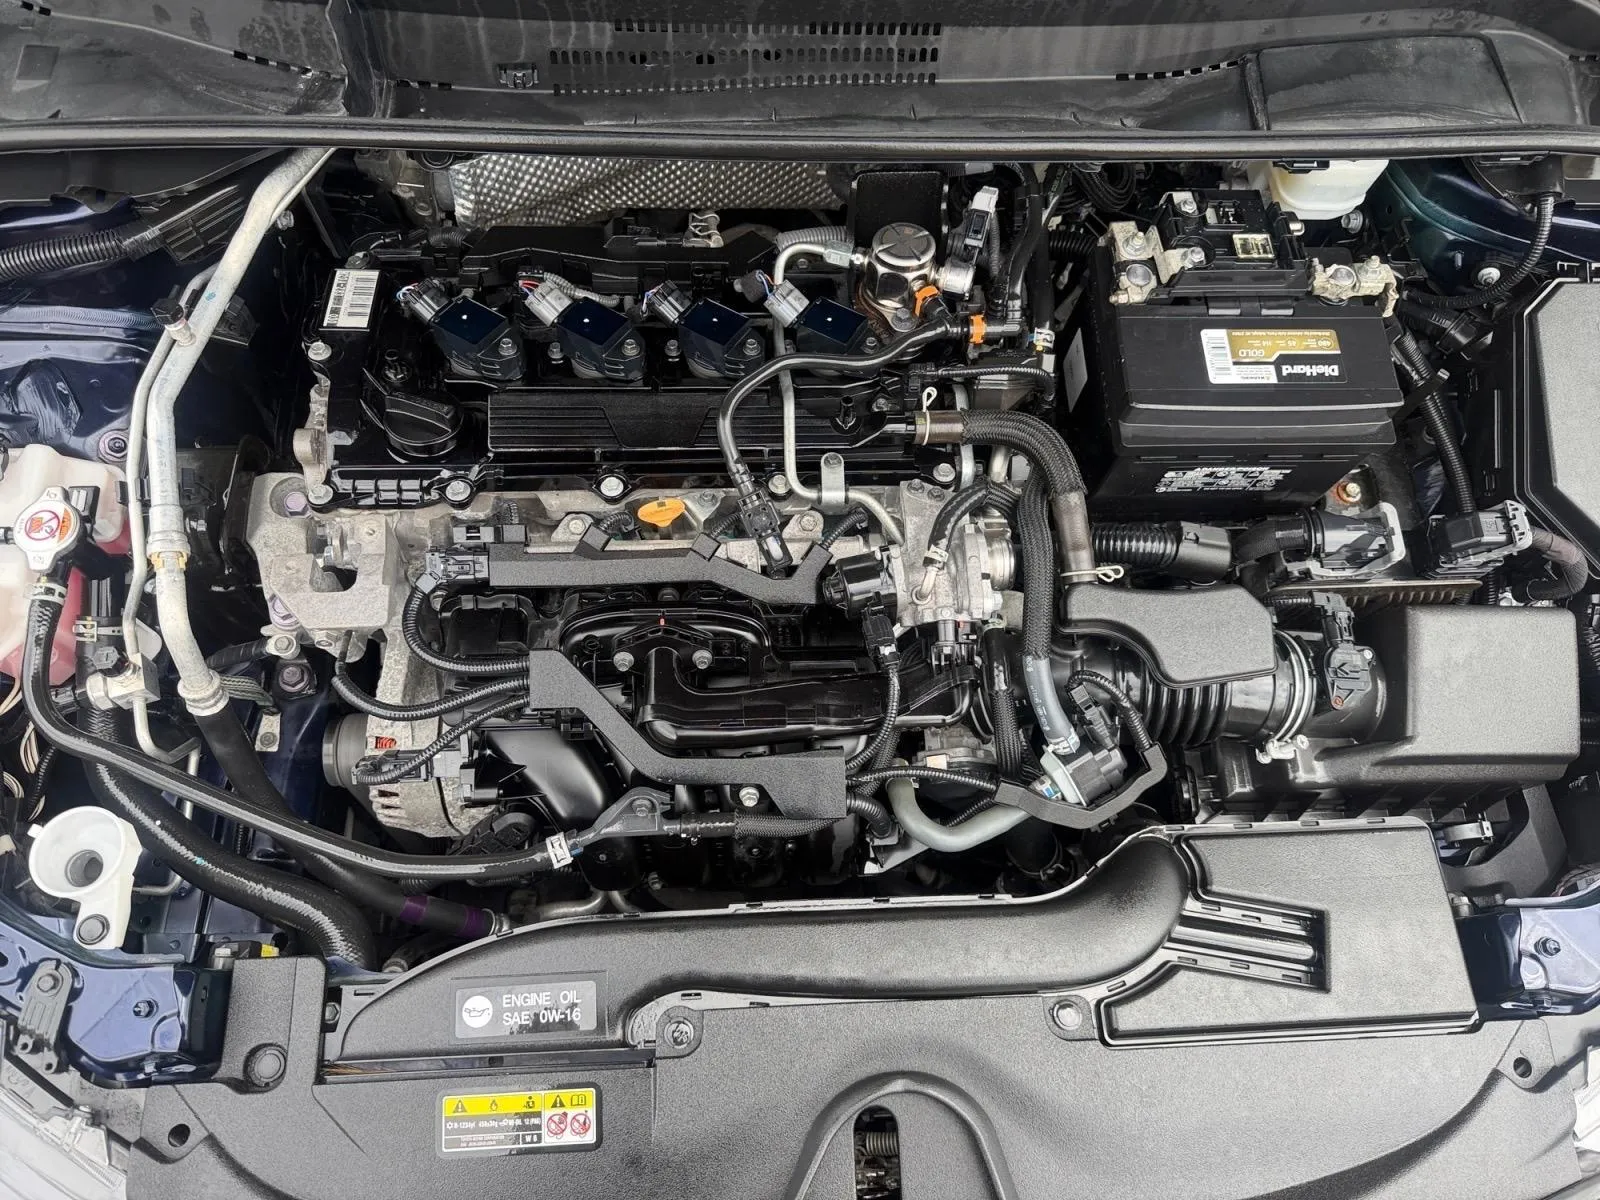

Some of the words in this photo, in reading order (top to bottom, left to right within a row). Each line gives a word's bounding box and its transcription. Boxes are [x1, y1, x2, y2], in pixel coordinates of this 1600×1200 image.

[1238, 349, 1265, 358] GOLD
[1281, 364, 1340, 377] DieHard
[502, 992, 551, 1007] ENGINE
[560, 990, 581, 1004] OIL
[502, 1011, 530, 1026] SAE
[539, 1008, 581, 1023] 0W-16
